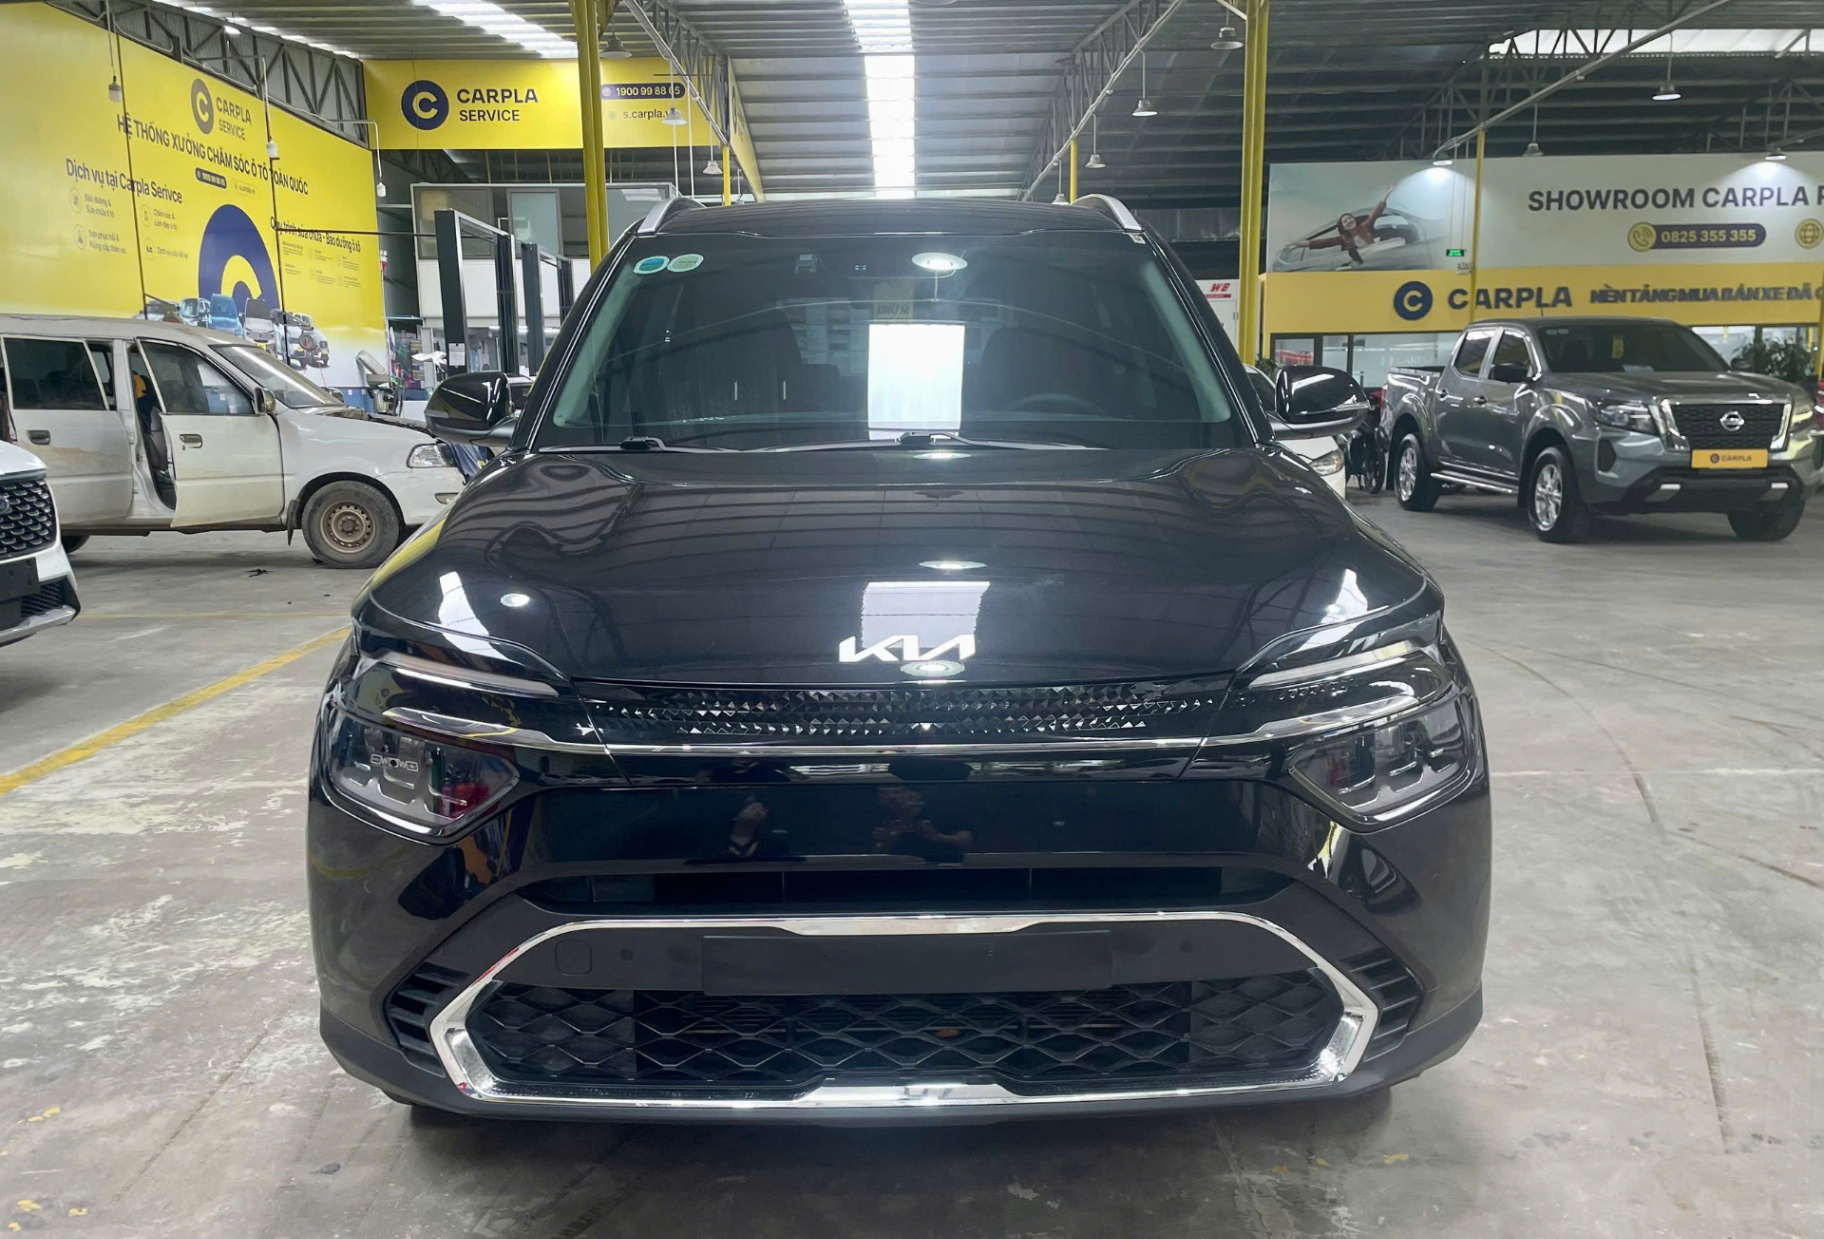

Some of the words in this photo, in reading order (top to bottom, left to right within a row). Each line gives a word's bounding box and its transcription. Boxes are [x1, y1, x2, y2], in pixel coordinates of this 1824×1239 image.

[457, 88, 539, 104] CARPLA
[616, 87, 639, 96] 1900
[640, 86, 653, 95] 99
[654, 86, 667, 95] 88
[216, 97, 252, 126] CARPLA
[459, 109, 520, 121] SERVICE
[219, 119, 246, 141] SERVICE
[133, 119, 169, 147] THỐNG
[171, 132, 205, 159] XƯỞNG
[207, 146, 233, 169] CHĂM
[234, 153, 250, 175] SÓC
[258, 162, 268, 181] TÔ
[289, 176, 308, 195] QUỐC
[66, 158, 90, 182] Dịch
[91, 168, 104, 188] vụ
[105, 170, 118, 191] tại
[120, 172, 150, 197] Carpla
[1528, 188, 1695, 211] SHOWROOM
[1702, 186, 1809, 207] CARPLA
[1661, 231, 1697, 243] 0825
[1700, 230, 1726, 242] 355
[1730, 229, 1756, 241] 355
[1448, 286, 1573, 310] CARPLA
[839, 634, 976, 662] KIA
